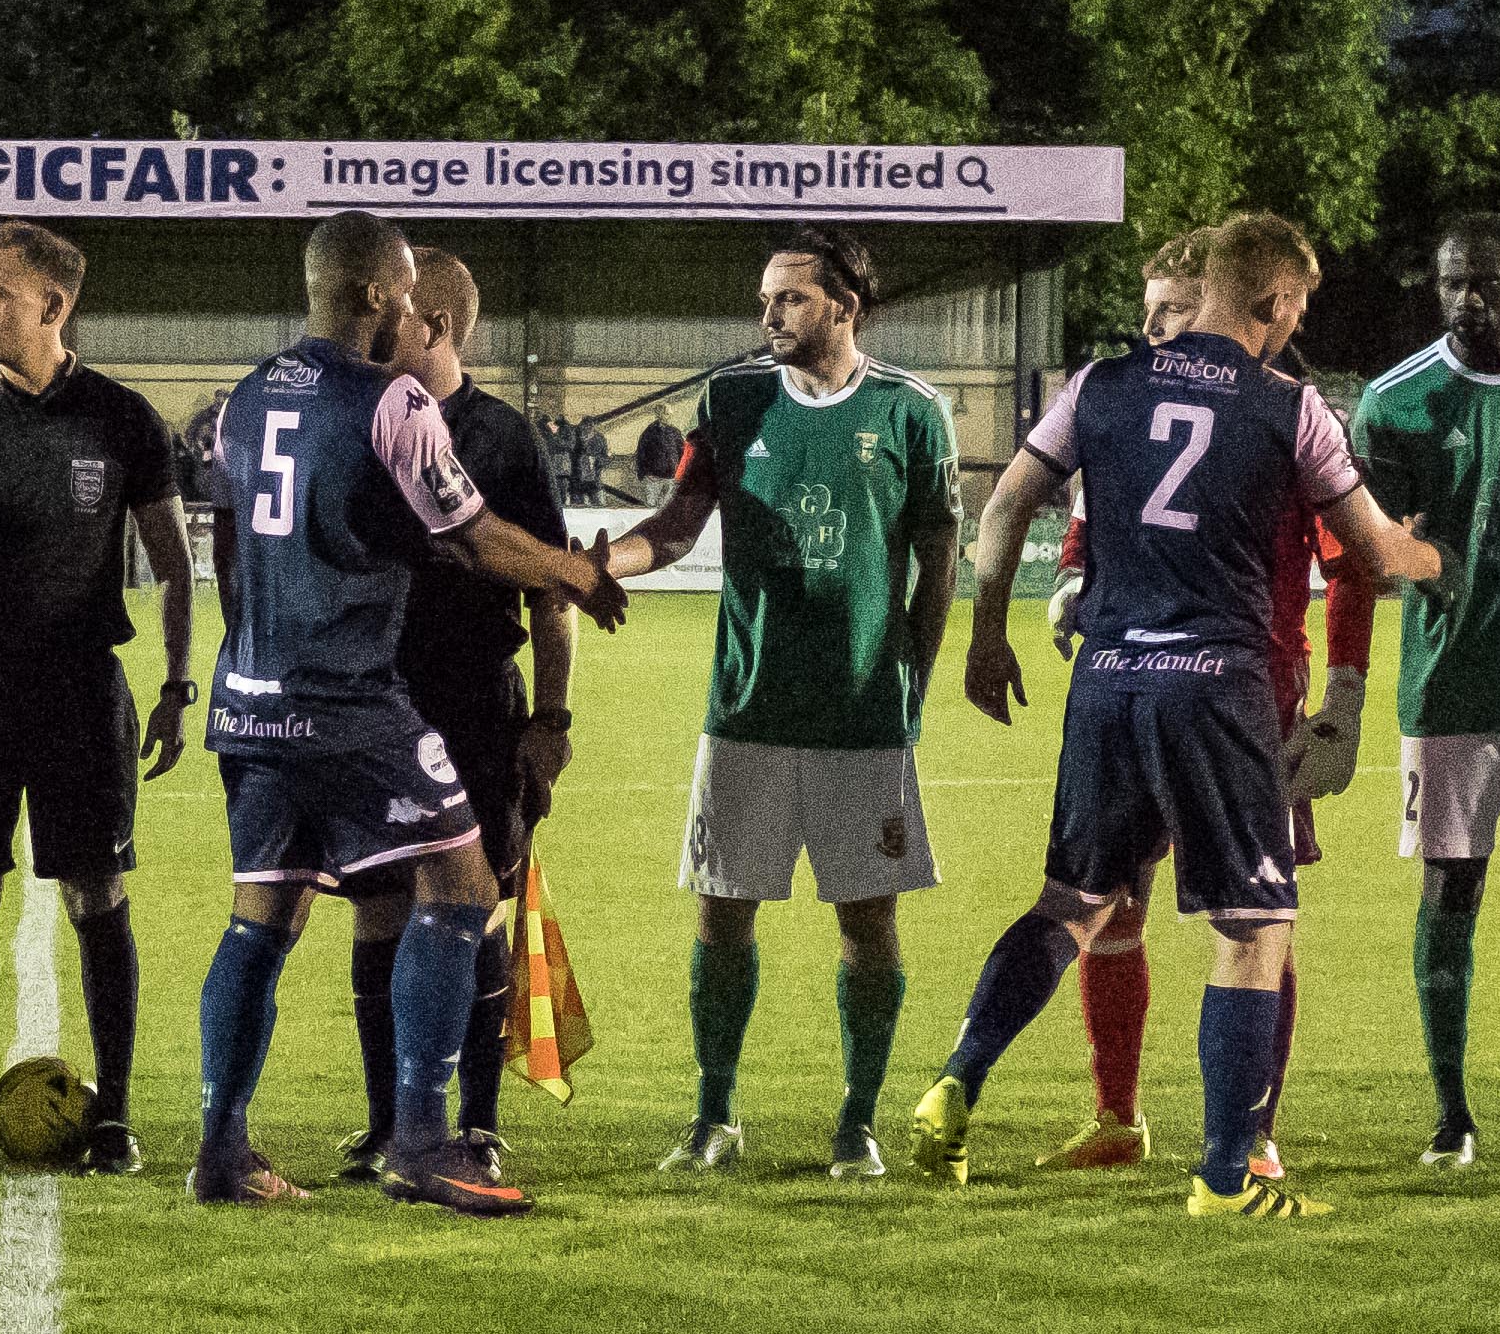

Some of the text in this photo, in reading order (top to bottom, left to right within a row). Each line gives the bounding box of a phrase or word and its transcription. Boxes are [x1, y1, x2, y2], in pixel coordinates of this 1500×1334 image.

[321, 146, 470, 197] image
[485, 146, 694, 198] licensing
[710, 148, 945, 198] simplified
[1152, 357, 1237, 384] UNISON
[252, 411, 300, 536] 5
[1142, 402, 1214, 530] 2
[1091, 650, 1224, 676] The Hamlet
[212, 707, 315, 739] The Hamlet
[1404, 769, 1420, 822] 2
